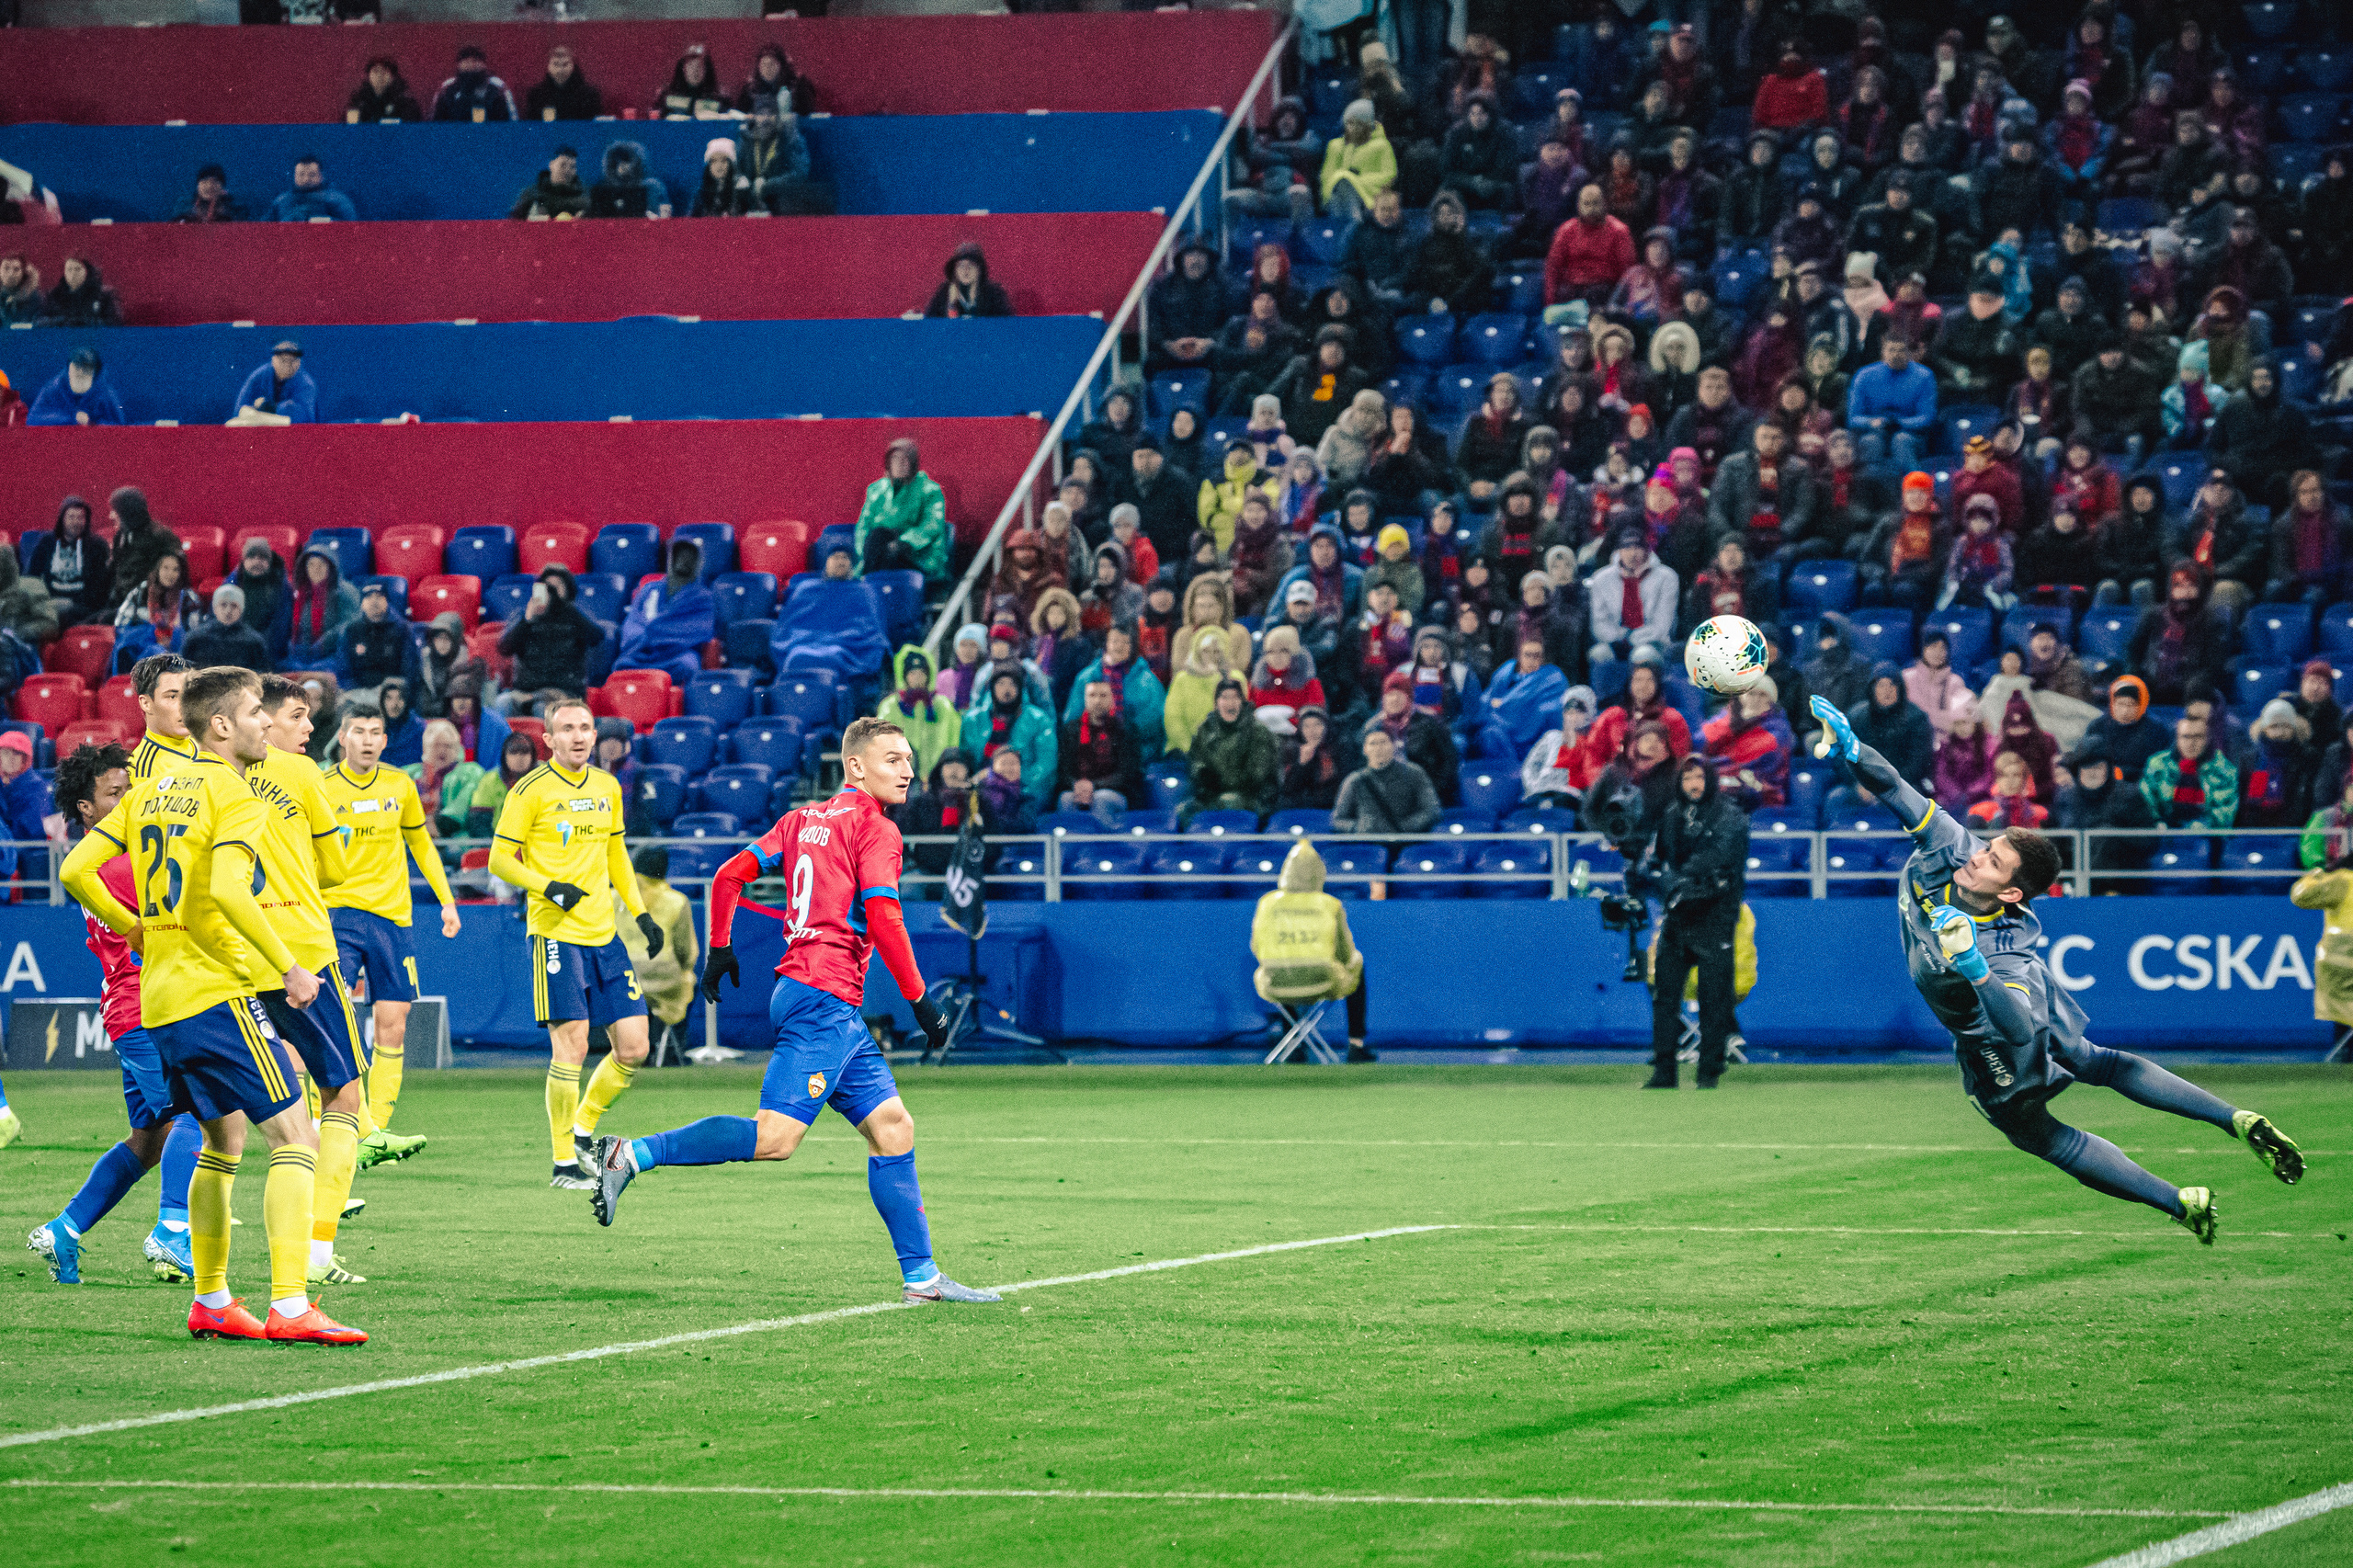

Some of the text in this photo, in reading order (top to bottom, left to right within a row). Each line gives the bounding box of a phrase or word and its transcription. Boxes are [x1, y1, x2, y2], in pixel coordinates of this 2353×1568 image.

[141, 795, 200, 818] ЛОГАШОВ
[249, 777, 299, 820] ДУНИЧ
[140, 824, 188, 917] 25
[787, 853, 813, 930] 9
[0, 940, 46, 993] A
[624, 970, 643, 1000] 3
[2127, 934, 2314, 991] CSKA
